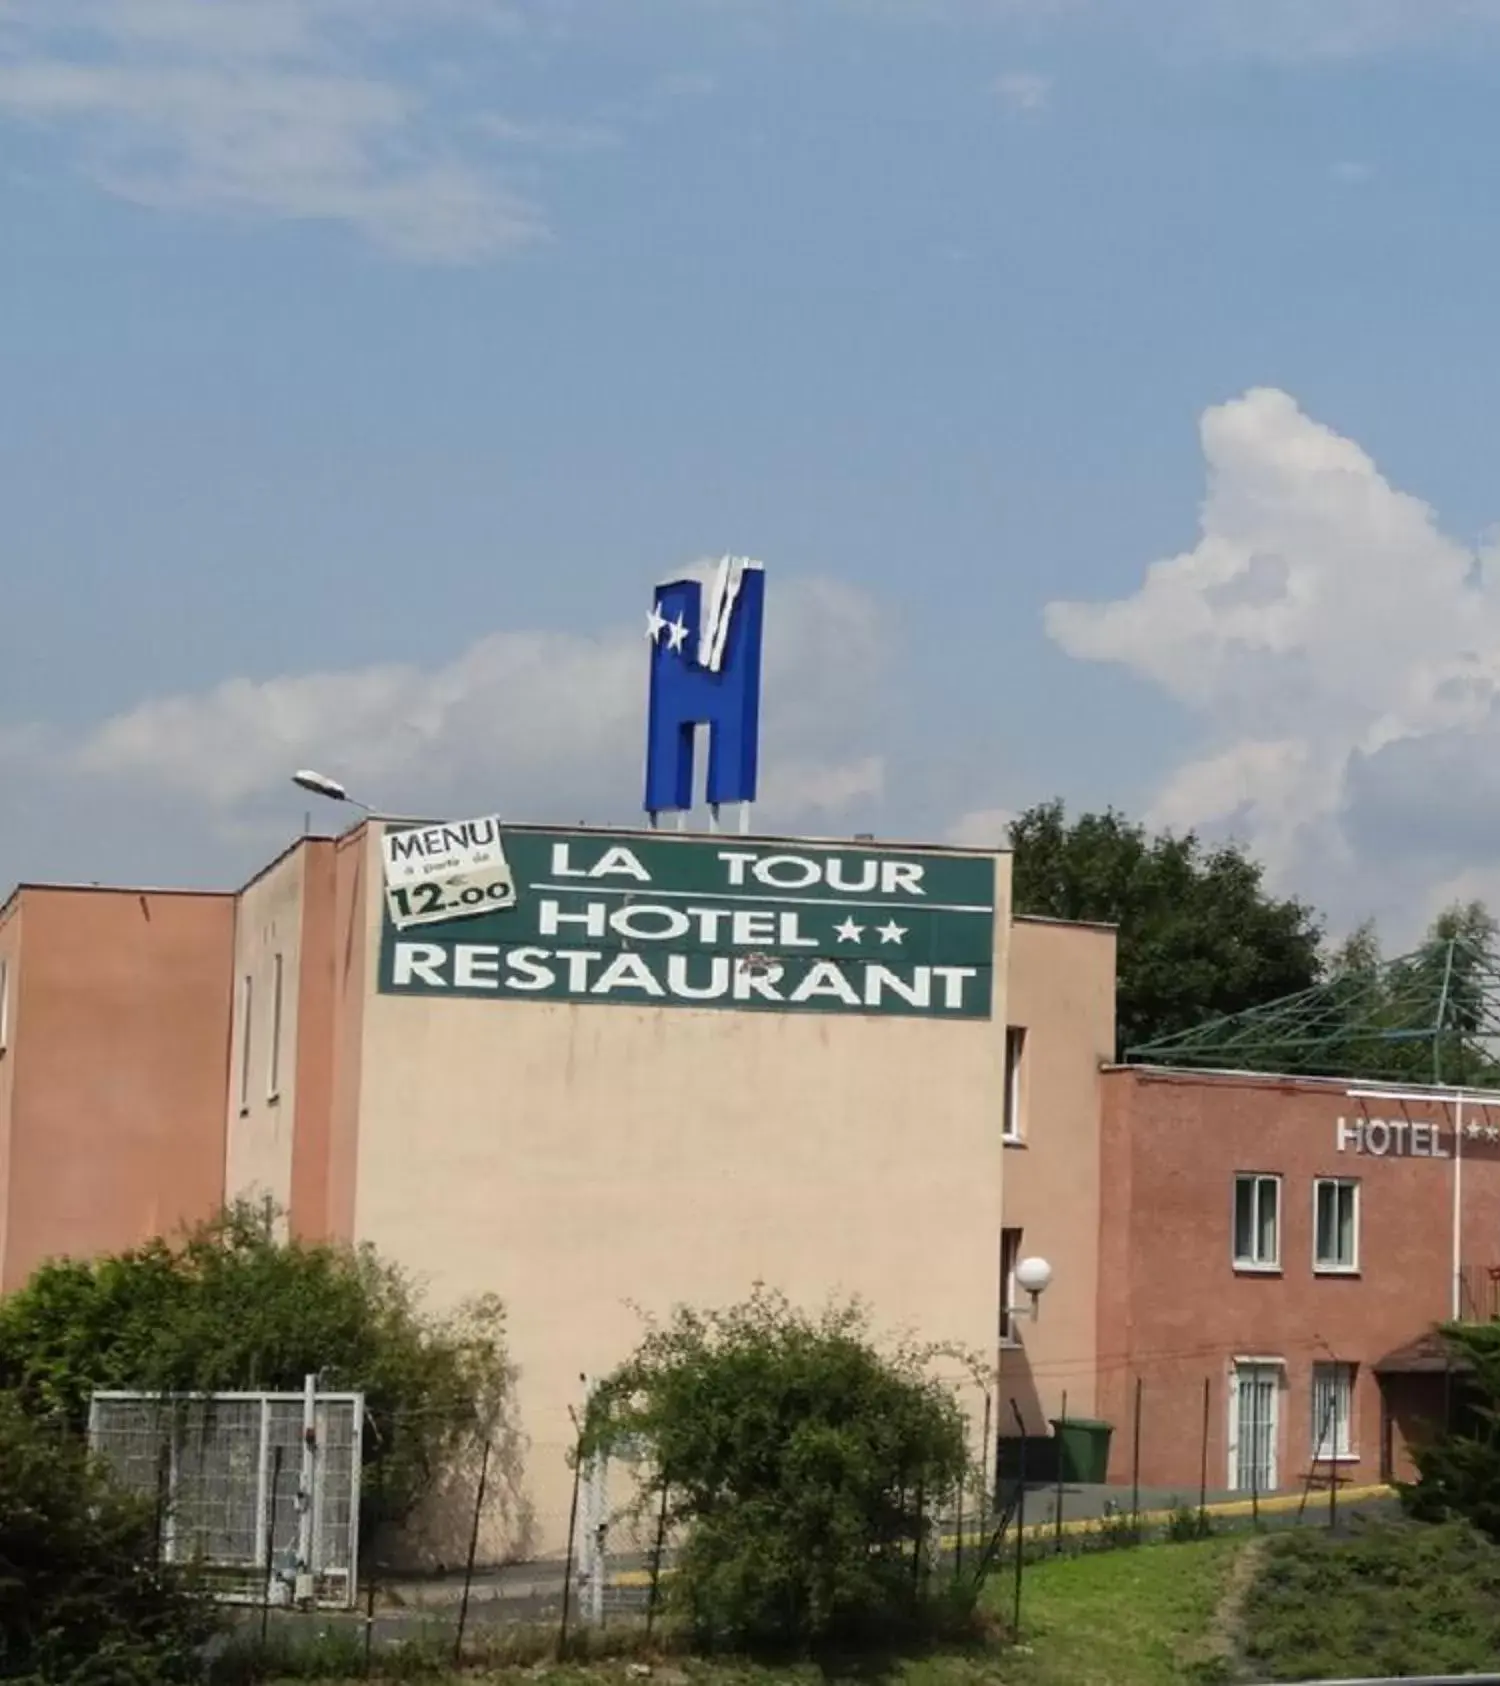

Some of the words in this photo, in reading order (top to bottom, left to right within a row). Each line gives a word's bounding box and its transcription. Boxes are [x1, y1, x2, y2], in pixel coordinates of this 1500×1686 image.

[391, 820, 494, 861] MENU
[551, 842, 651, 882] LA
[718, 851, 927, 895] TOUR
[538, 900, 820, 947] HOTEL
[392, 942, 977, 1010] RESTAURANT
[1336, 1115, 1450, 1158] HOTEL
